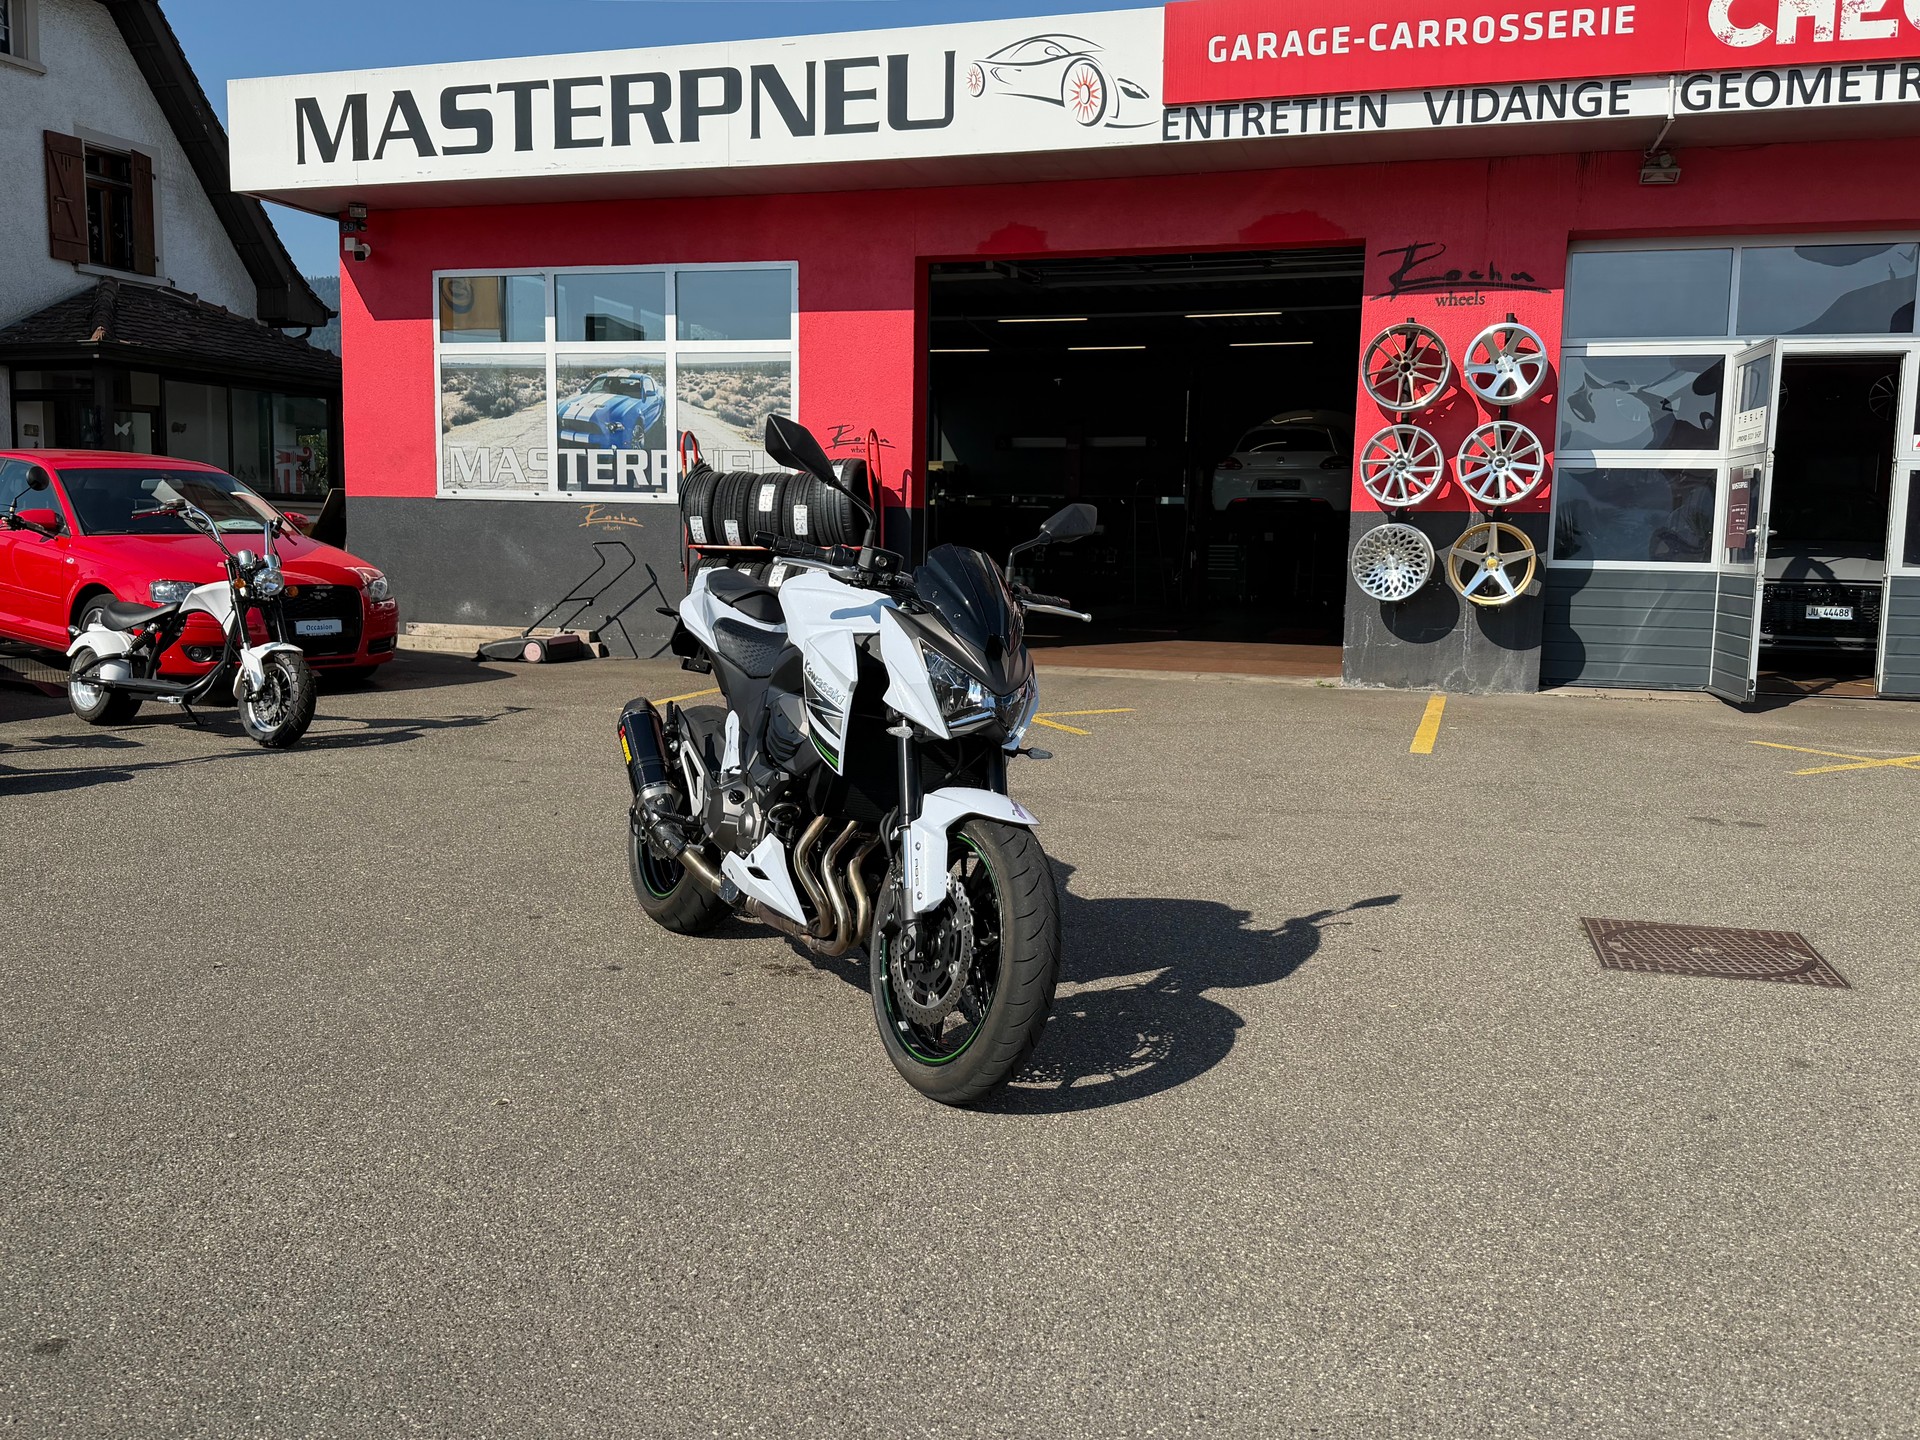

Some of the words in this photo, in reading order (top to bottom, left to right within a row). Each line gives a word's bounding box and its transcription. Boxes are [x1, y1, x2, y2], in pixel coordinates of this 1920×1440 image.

[1207, 4, 1636, 64] GARAGE-CARROSSERIE
[1708, 0, 1920, 48] CHE
[295, 50, 956, 166] MASTERPNEU
[1162, 93, 1388, 142] ENTRETIEN
[1422, 79, 1633, 127] VIDANGE
[1679, 62, 1920, 112] GEOMETR
[1435, 290, 1486, 307] wheels
[305, 623, 333, 632] Occasion
[804, 659, 846, 706] Kawasaki
